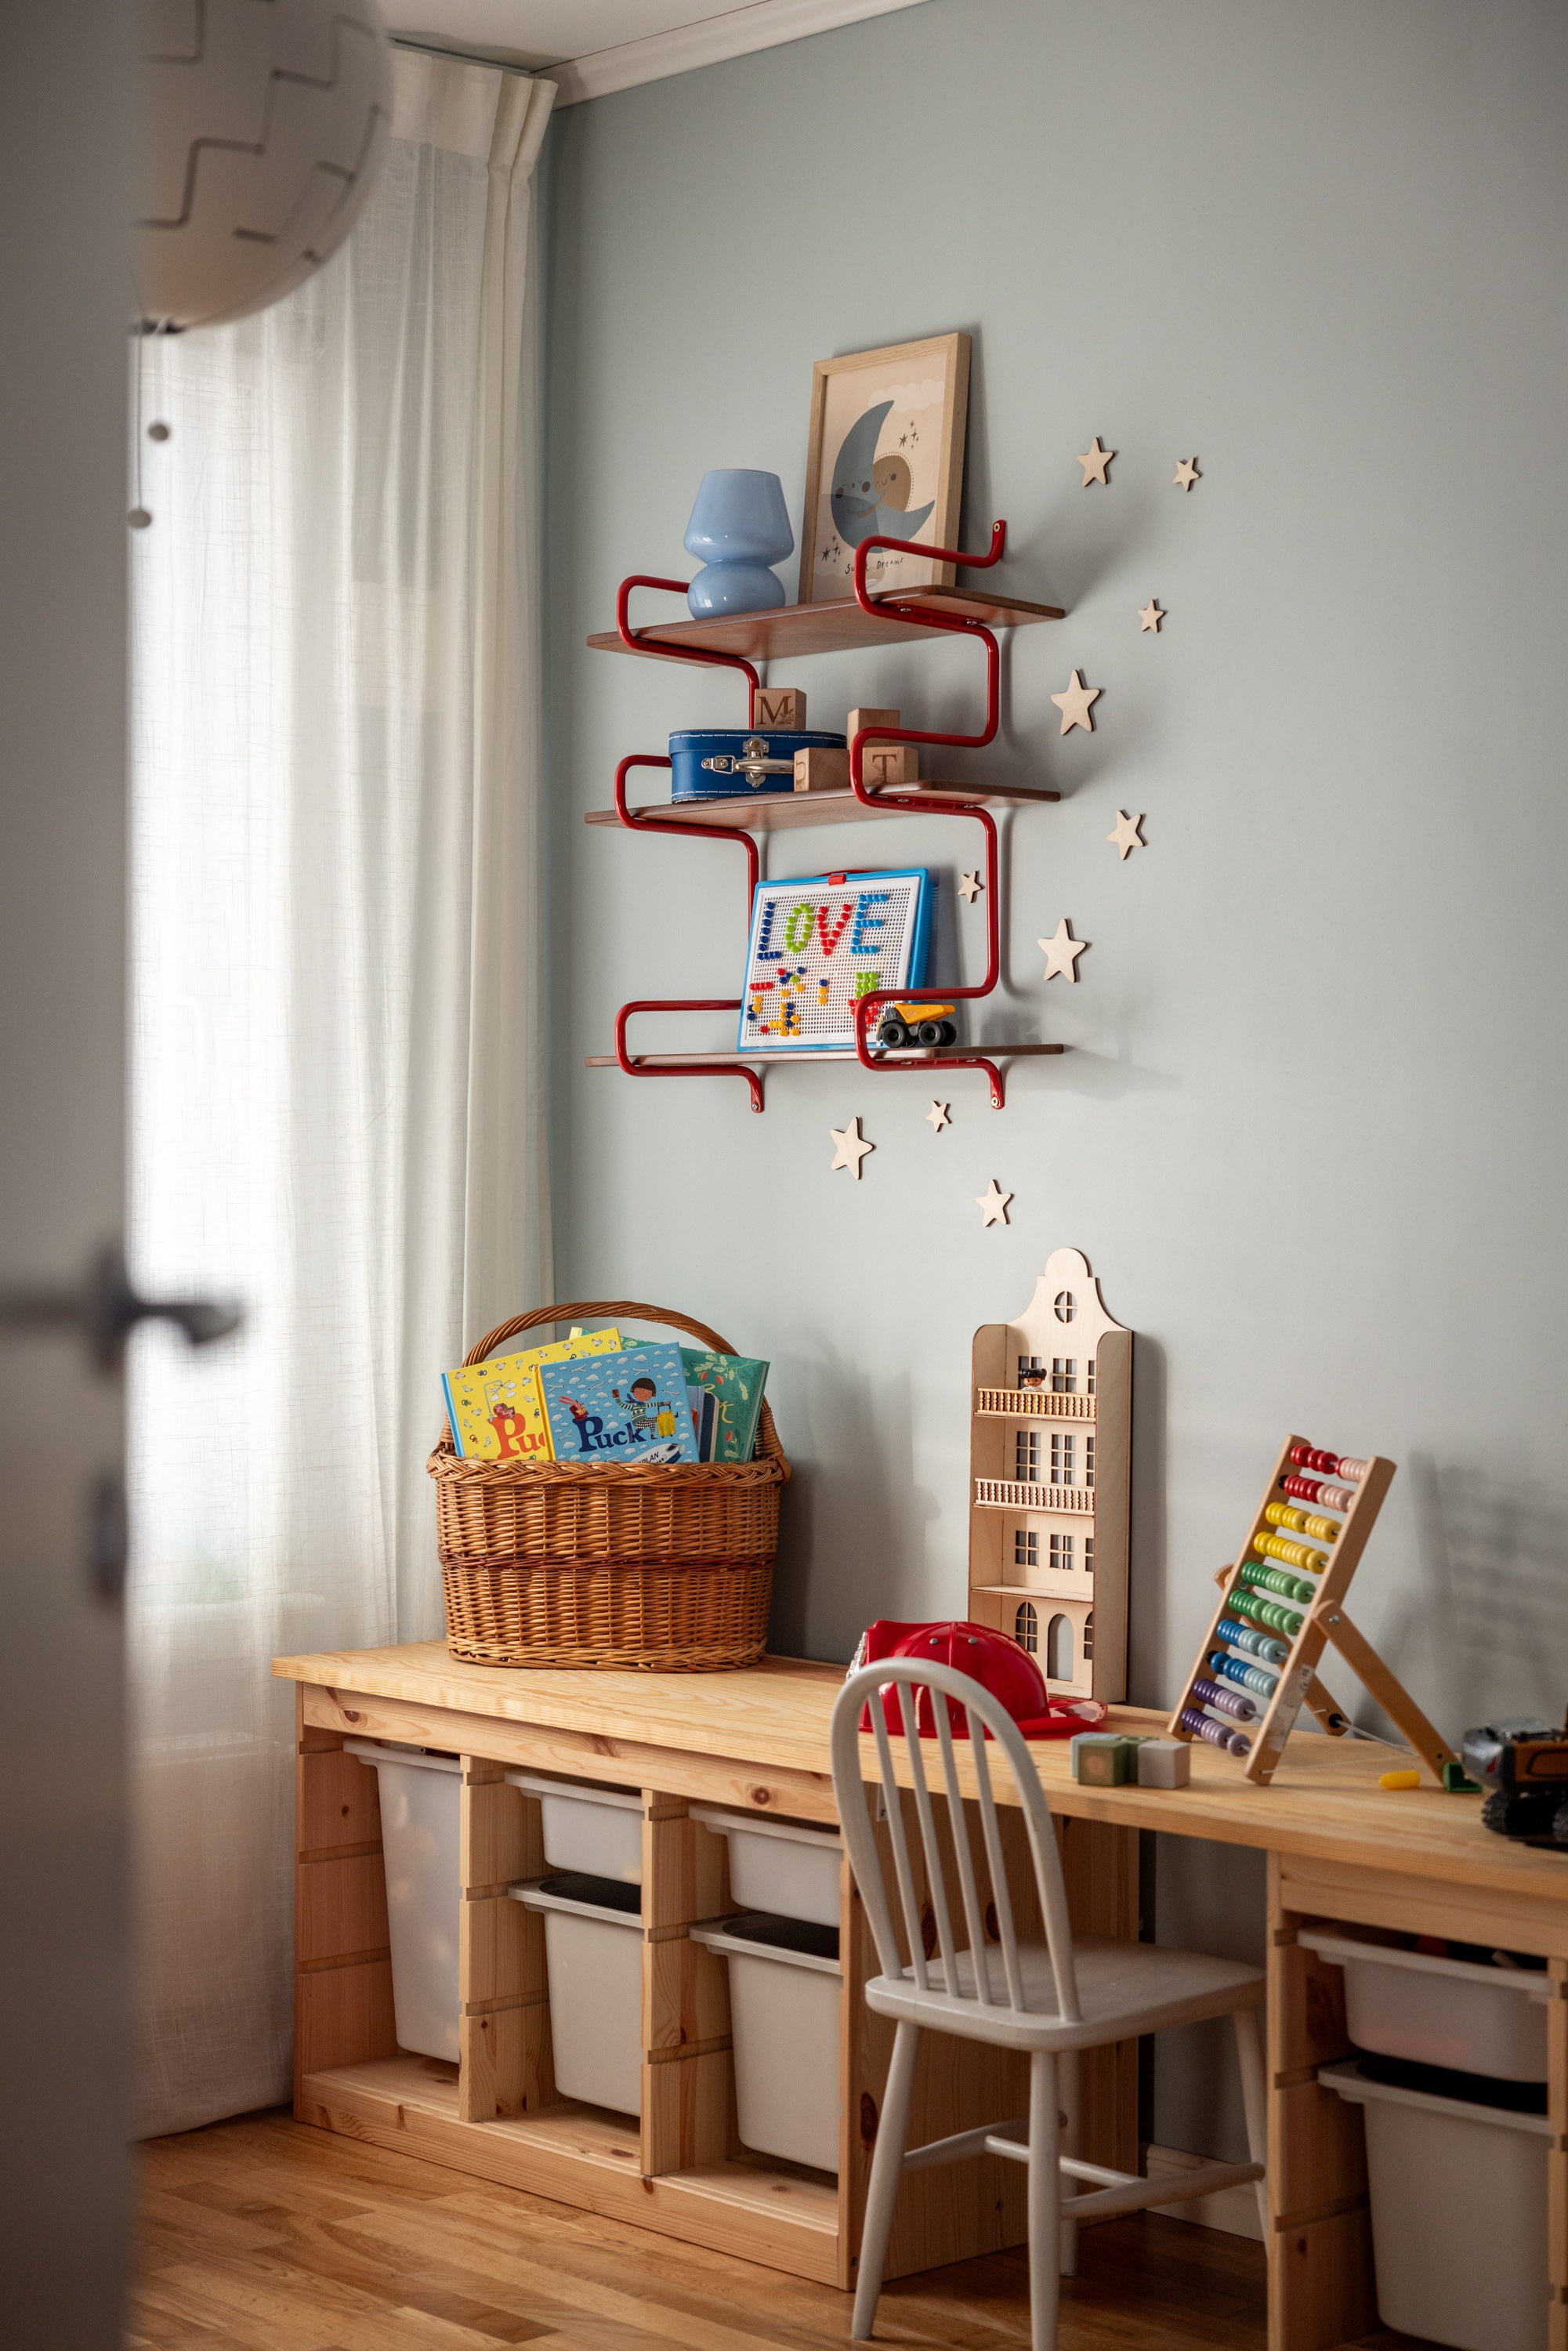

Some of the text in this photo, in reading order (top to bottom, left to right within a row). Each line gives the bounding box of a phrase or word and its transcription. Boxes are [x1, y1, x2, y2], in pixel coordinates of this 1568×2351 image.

[877, 557, 904, 570] Dreams
[757, 695, 794, 725] M
[872, 753, 897, 784] T
[757, 893, 889, 960] LOVE
[573, 1416, 646, 1452] Puck
[639, 1451, 659, 1463] PLAN
